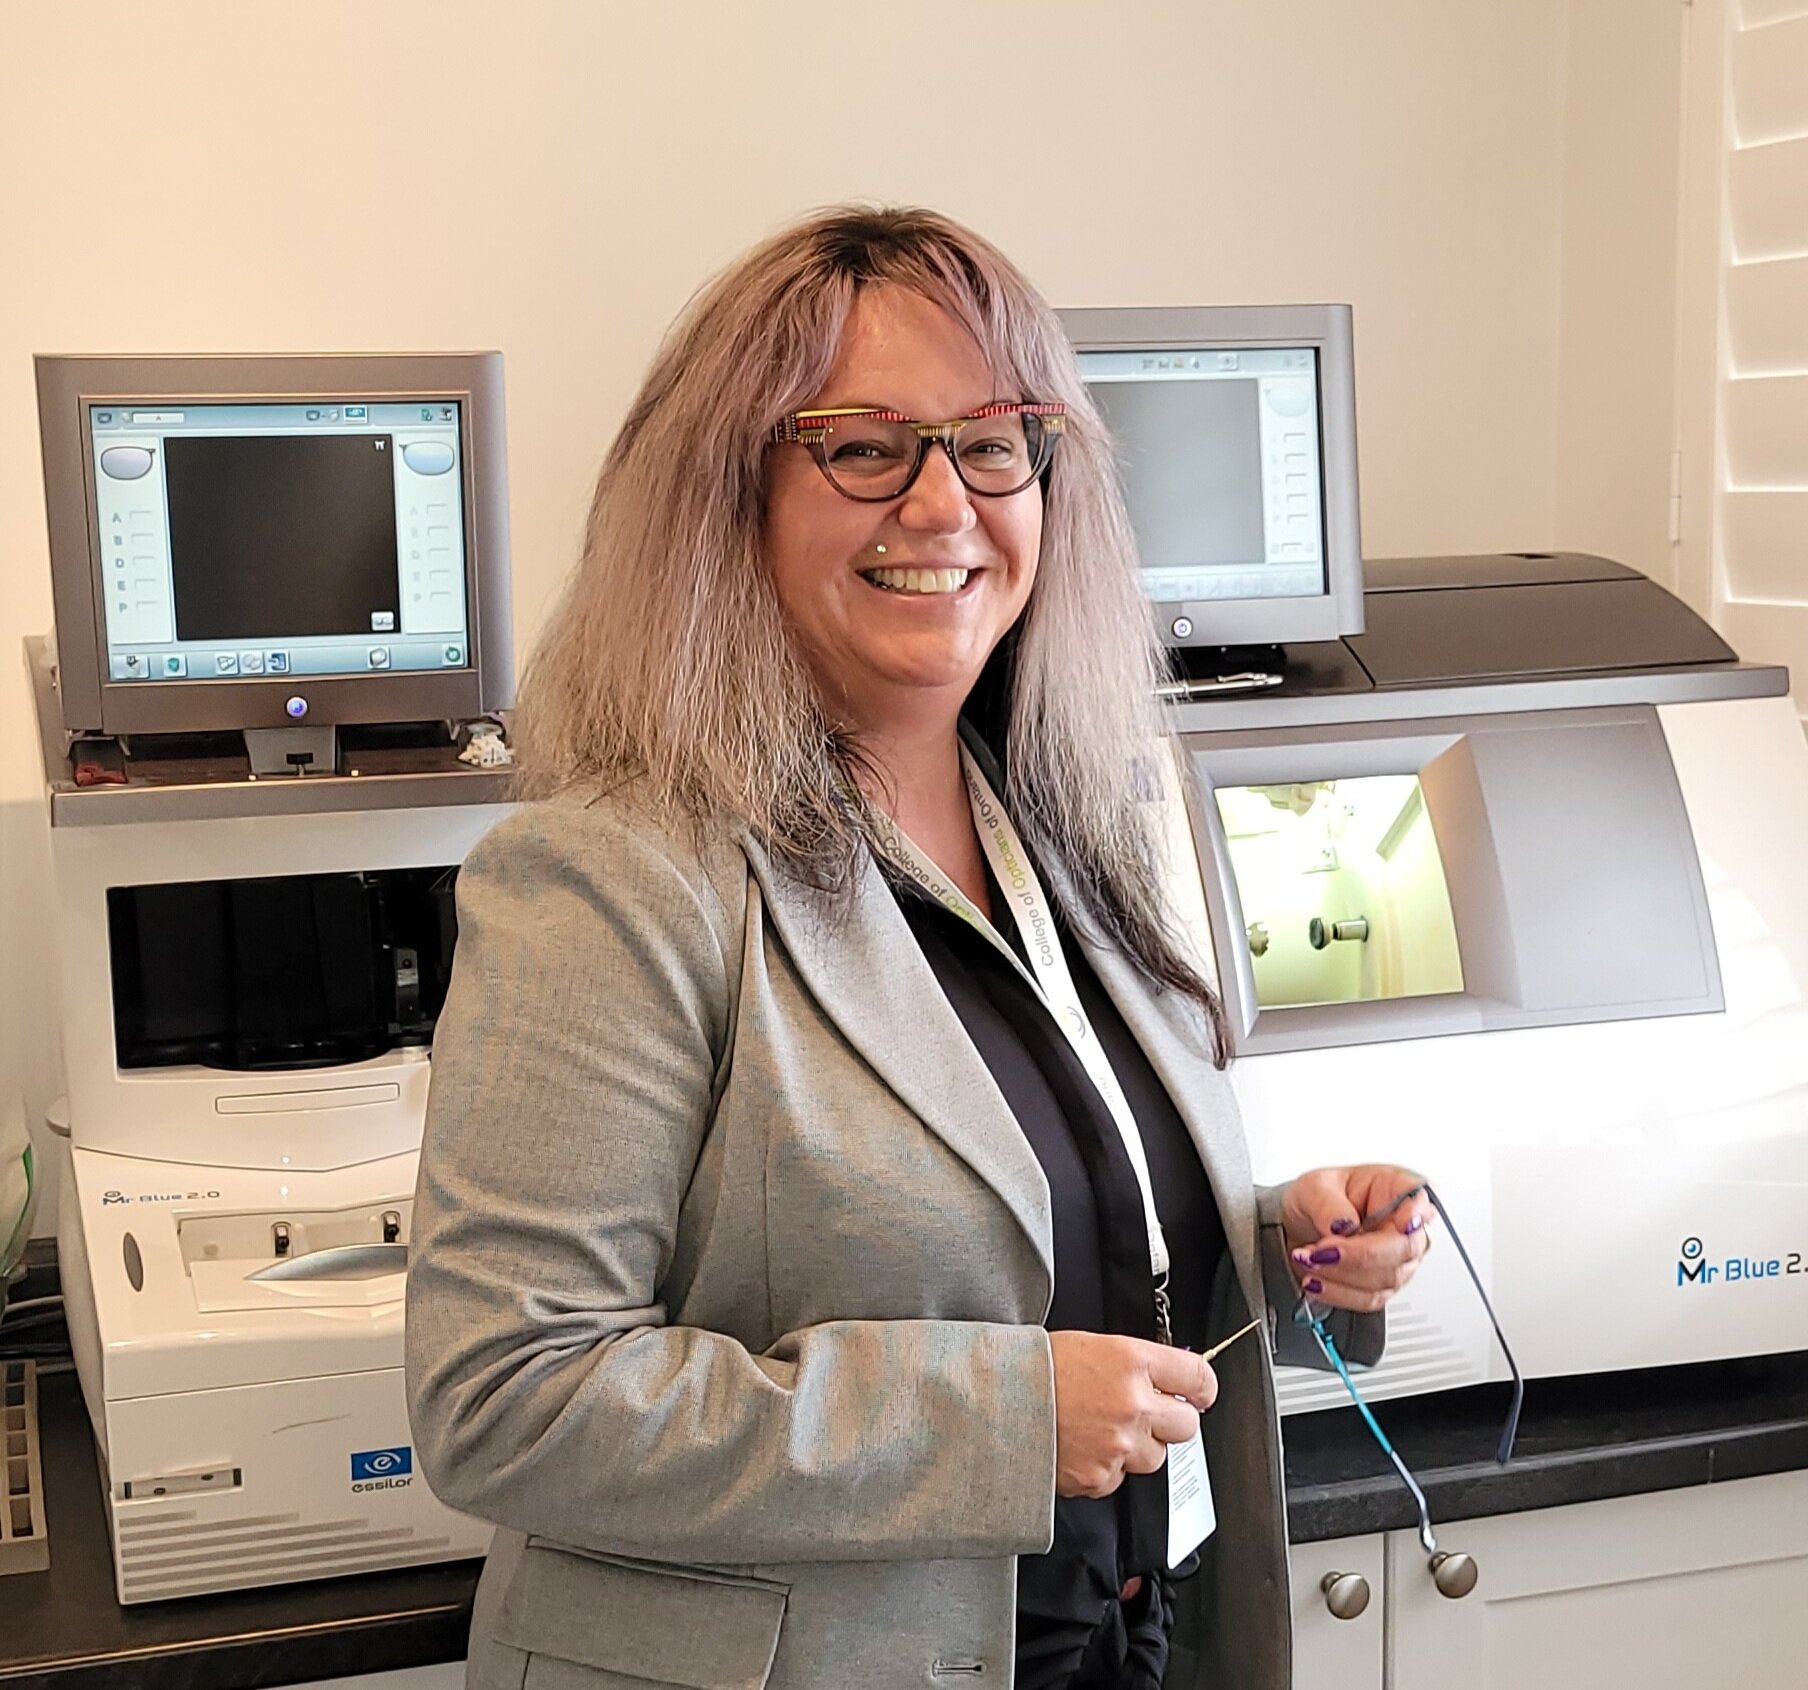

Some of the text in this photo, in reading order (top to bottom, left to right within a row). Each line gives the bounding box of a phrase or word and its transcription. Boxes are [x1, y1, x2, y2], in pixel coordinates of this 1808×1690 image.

[112, 512, 122, 523] A
[115, 558, 124, 568] D
[117, 581, 126, 591] E
[119, 603, 128, 613] P
[985, 815, 999, 829] of
[930, 883, 947, 898] of
[1017, 891, 1034, 906] of
[1029, 908, 1054, 966] College
[102, 1195, 134, 1206] Mr
[187, 1190, 220, 1200] 2.0
[1677, 1257, 1719, 1287] Mr
[1725, 1257, 1780, 1281] Blue
